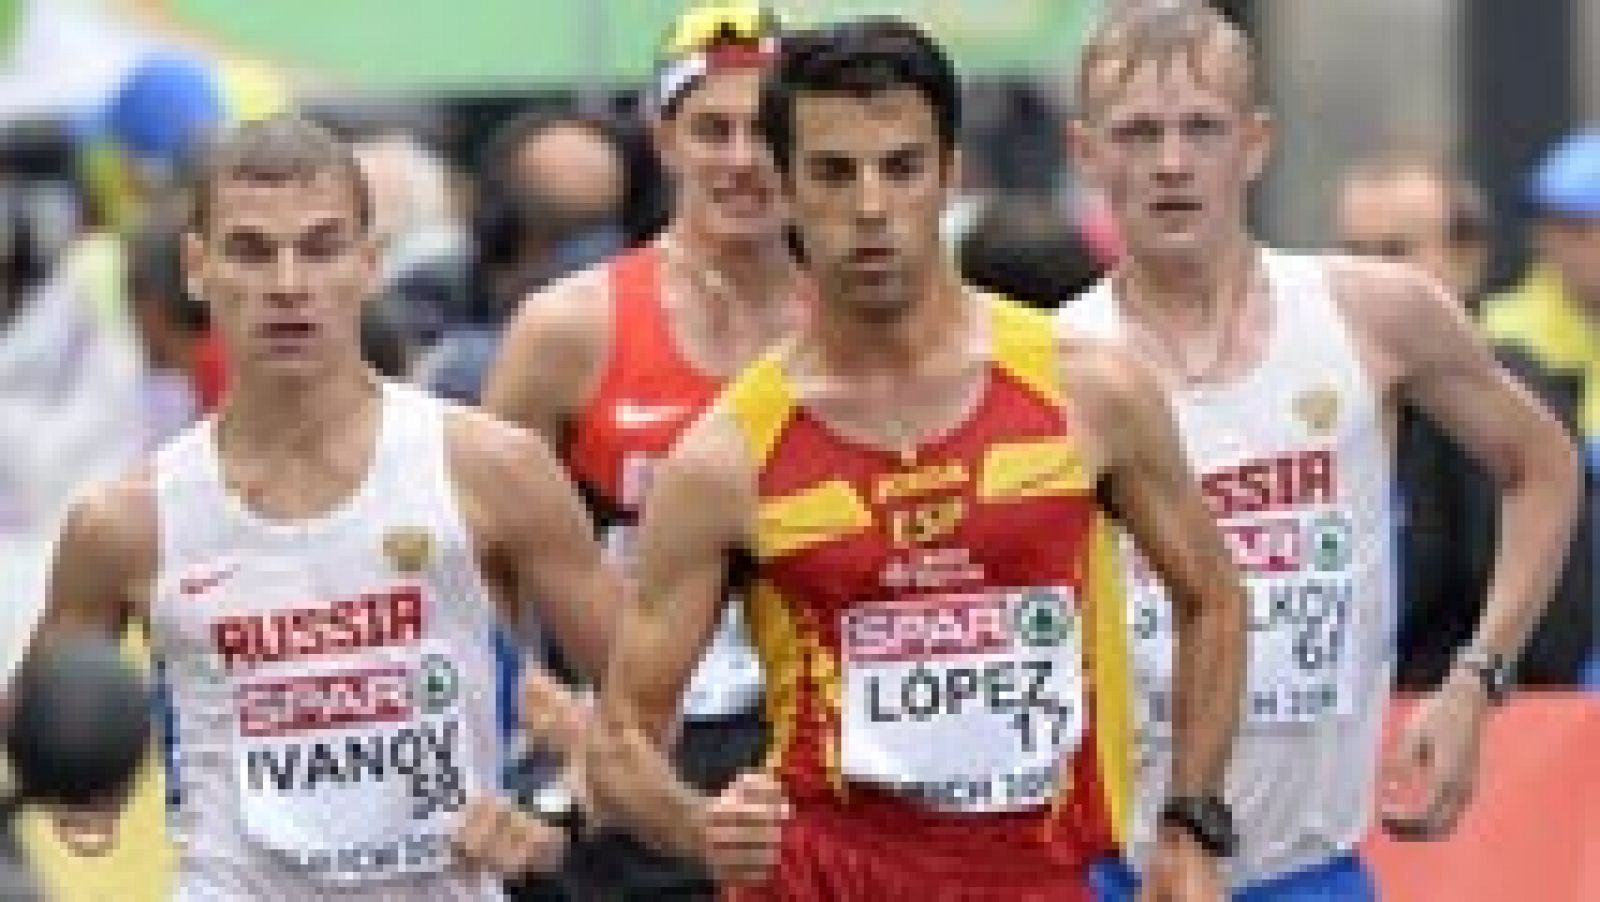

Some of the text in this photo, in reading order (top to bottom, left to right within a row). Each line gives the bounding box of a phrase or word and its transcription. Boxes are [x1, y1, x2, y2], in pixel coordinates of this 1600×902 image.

[1200, 450, 1331, 516] SSIA
[213, 586, 423, 668] RUSSIA
[846, 604, 1008, 662] SPAR
[242, 672, 412, 736] SPAR
[1013, 700, 1070, 752] 17
[246, 721, 459, 791] IVANOV
